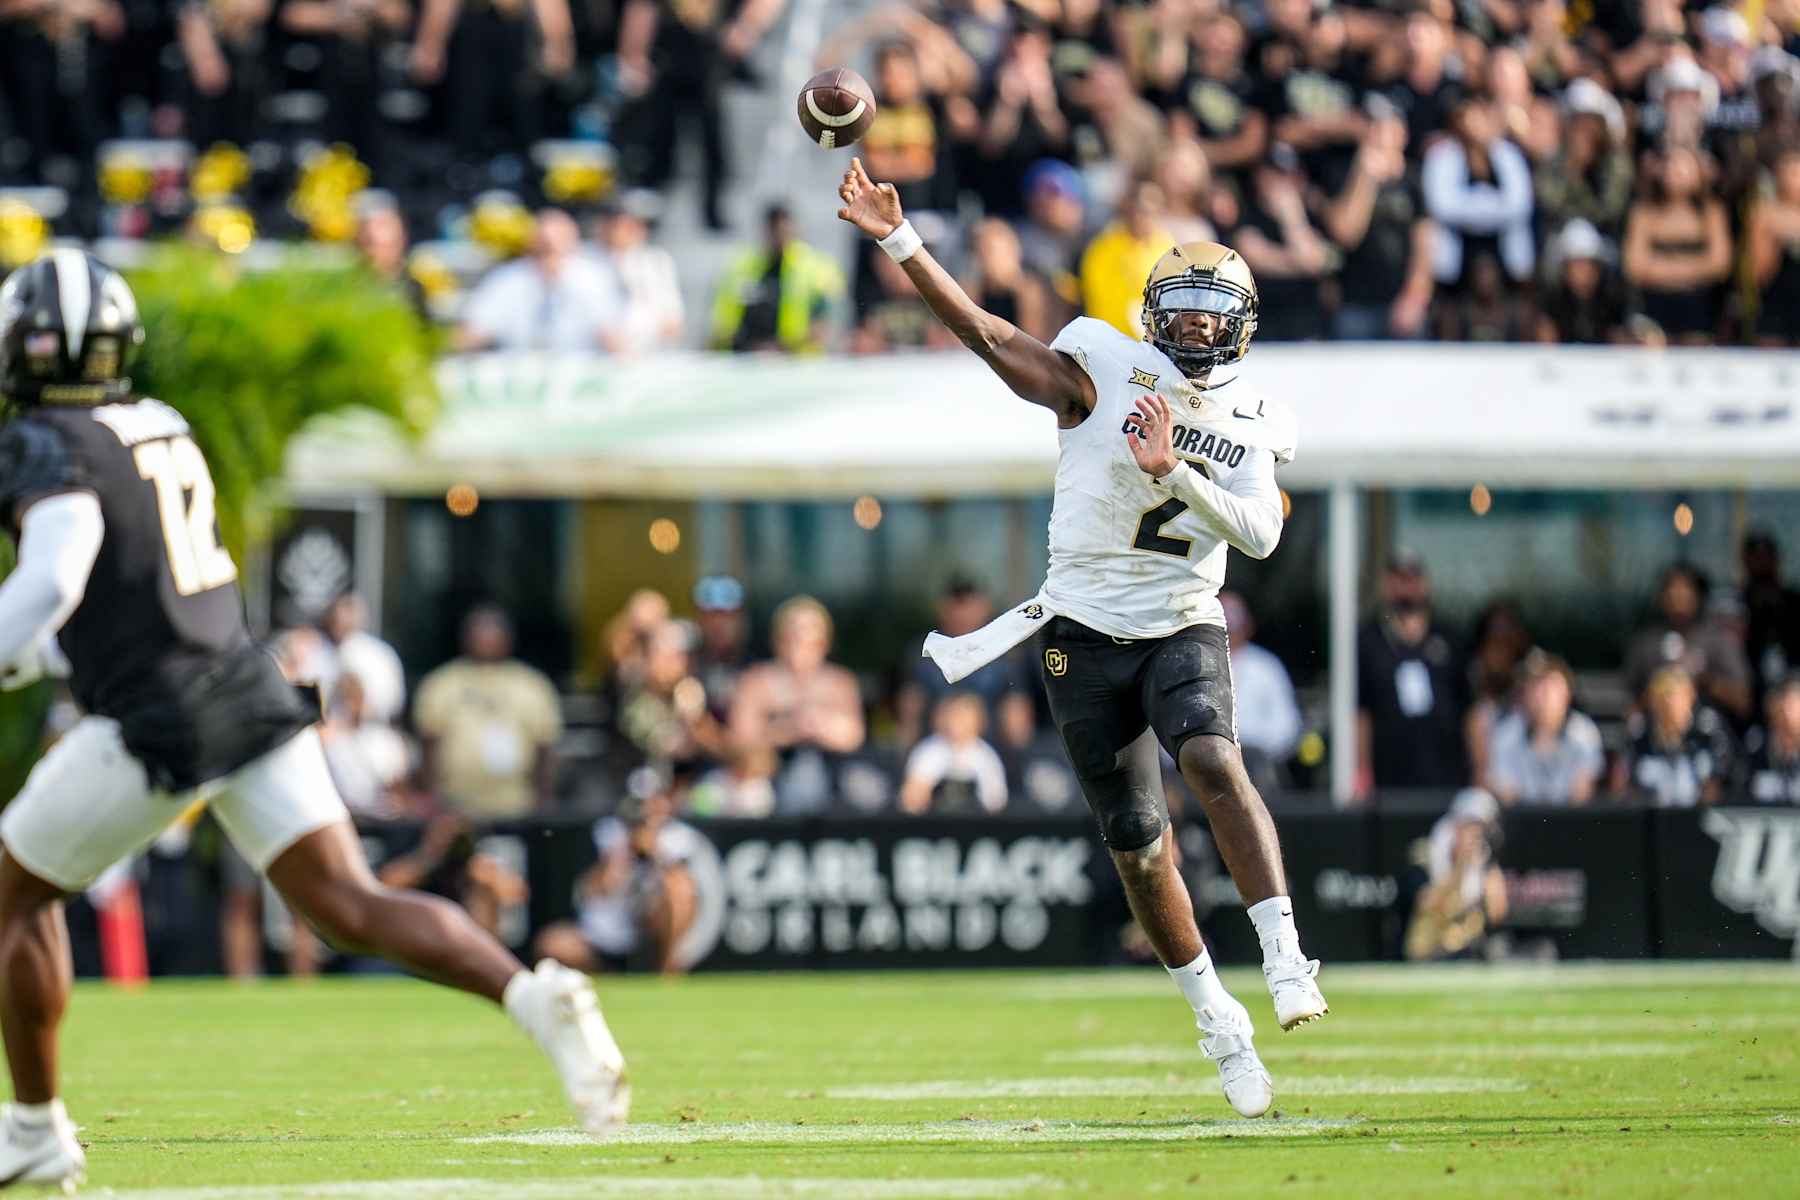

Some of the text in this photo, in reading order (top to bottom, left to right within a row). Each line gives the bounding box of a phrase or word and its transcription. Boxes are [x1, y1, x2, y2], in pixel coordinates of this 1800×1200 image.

[1121, 412, 1247, 469] CORADO
[132, 435, 238, 597] 12
[1130, 455, 1213, 560] 2
[1045, 648, 1068, 677] CU
[724, 836, 1092, 905] CARL BLACK
[725, 902, 1049, 954] ORLANDO
